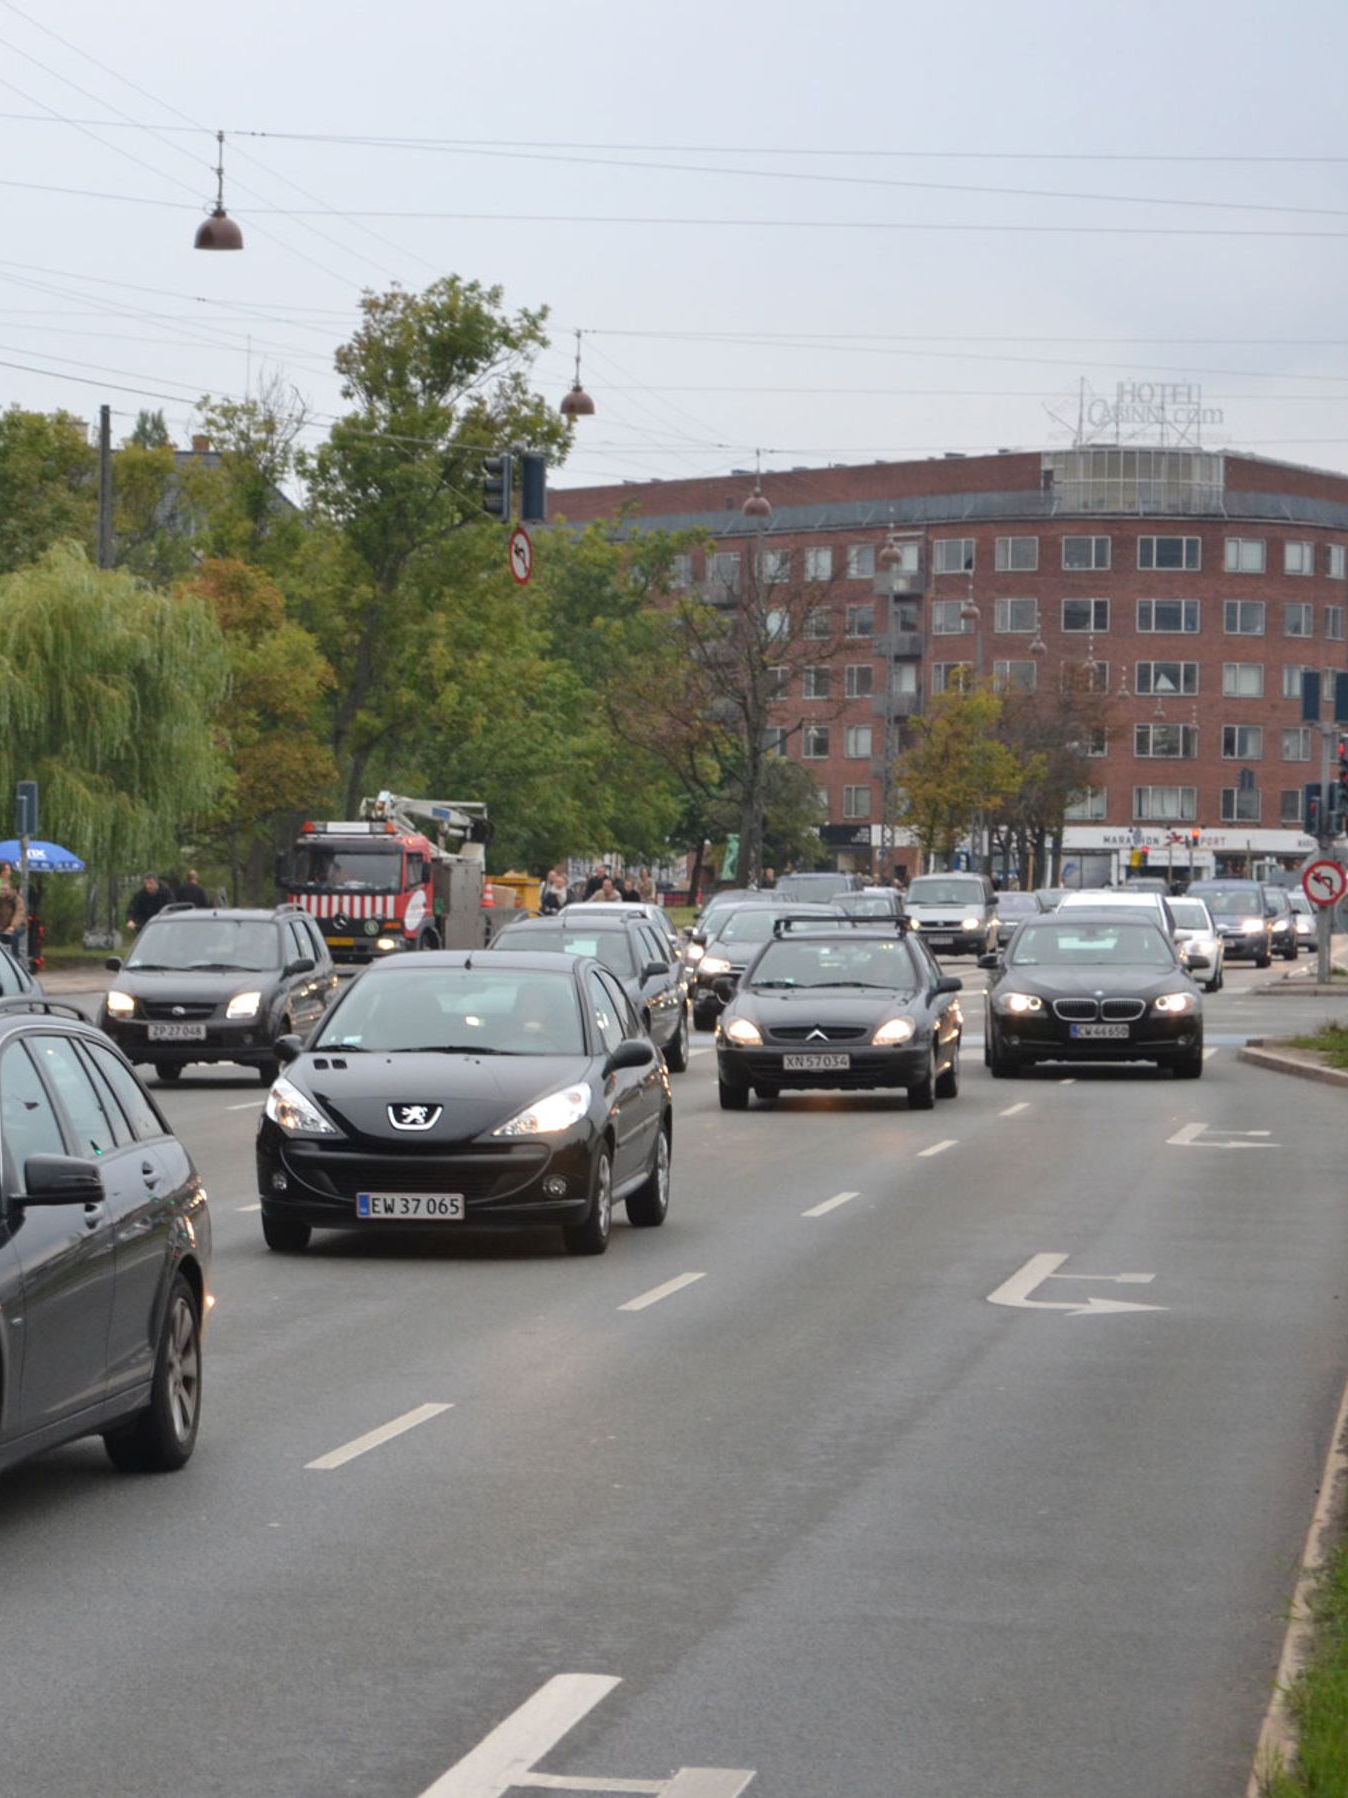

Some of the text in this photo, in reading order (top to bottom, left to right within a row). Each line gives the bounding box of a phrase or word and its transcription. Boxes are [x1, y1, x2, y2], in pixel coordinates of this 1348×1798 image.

[1119, 382, 1199, 404] HOTEL
[1103, 835, 1226, 846] MARAHON PORT
